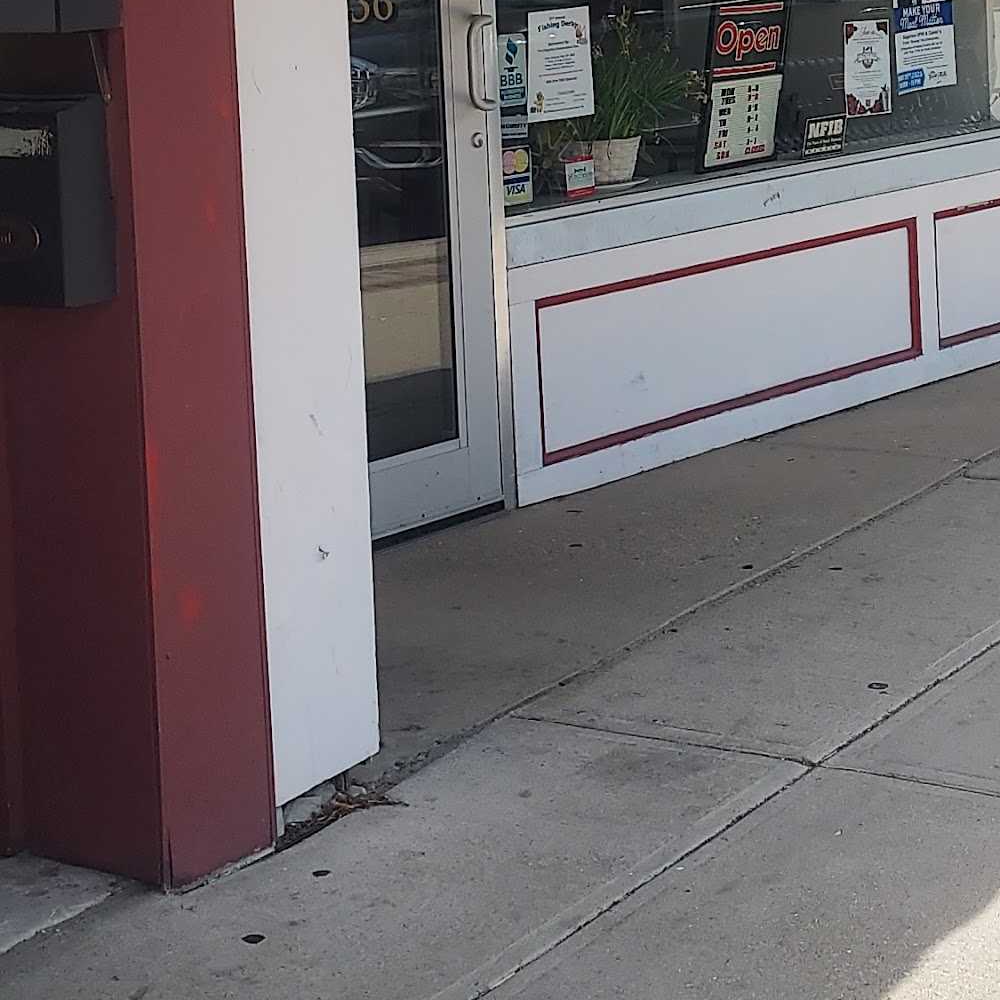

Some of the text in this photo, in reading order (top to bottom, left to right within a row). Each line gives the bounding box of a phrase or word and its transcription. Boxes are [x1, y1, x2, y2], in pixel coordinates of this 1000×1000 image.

[903, 3, 941, 17] MAKE YOUR
[537, 20, 579, 33] Fishing Derby
[716, 20, 781, 61] Open
[500, 73, 523, 87] BBB
[808, 119, 844, 139] NFIB
[714, 140, 727, 149] SAT
[506, 183, 526, 195] VISA
